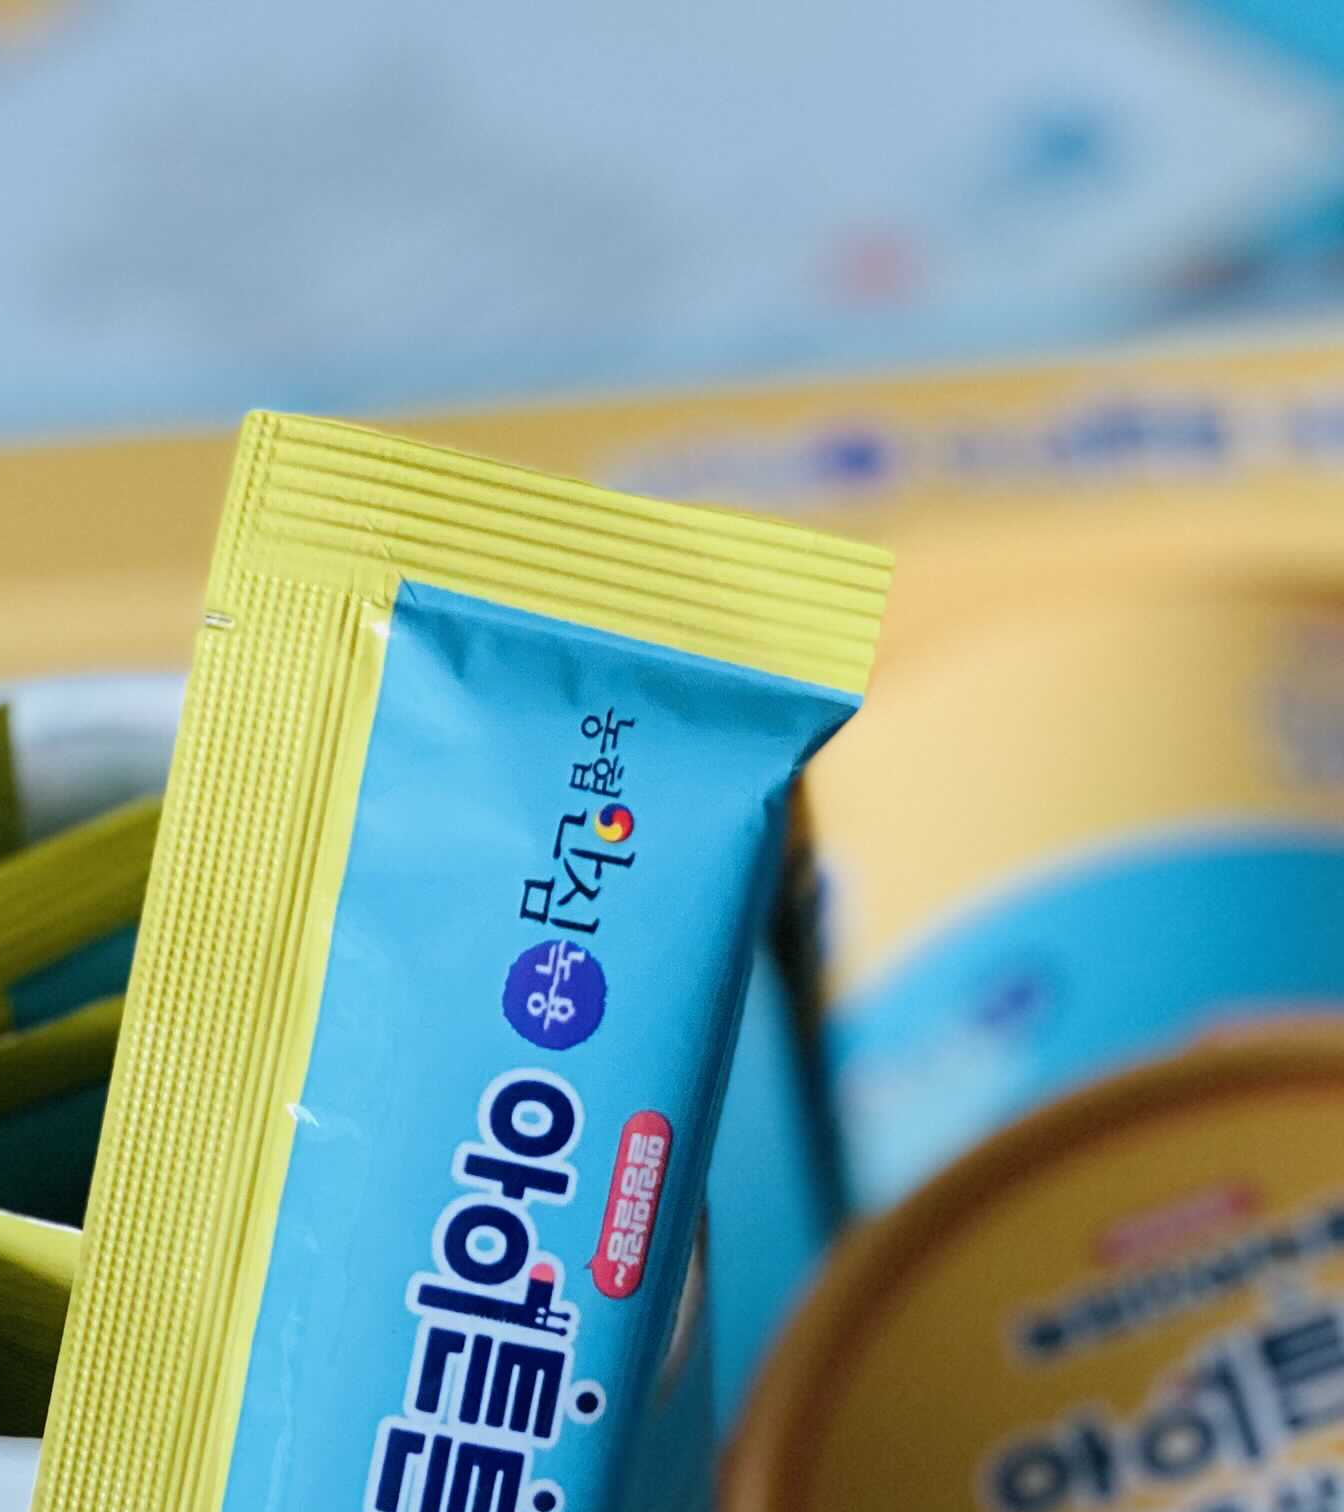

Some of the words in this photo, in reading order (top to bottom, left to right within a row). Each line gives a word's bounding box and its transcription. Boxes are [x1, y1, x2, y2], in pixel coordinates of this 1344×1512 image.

[568, 706, 636, 799] 농협
[527, 939, 586, 1032] 녹용
[607, 1132, 665, 1288] 말랑말랑~
